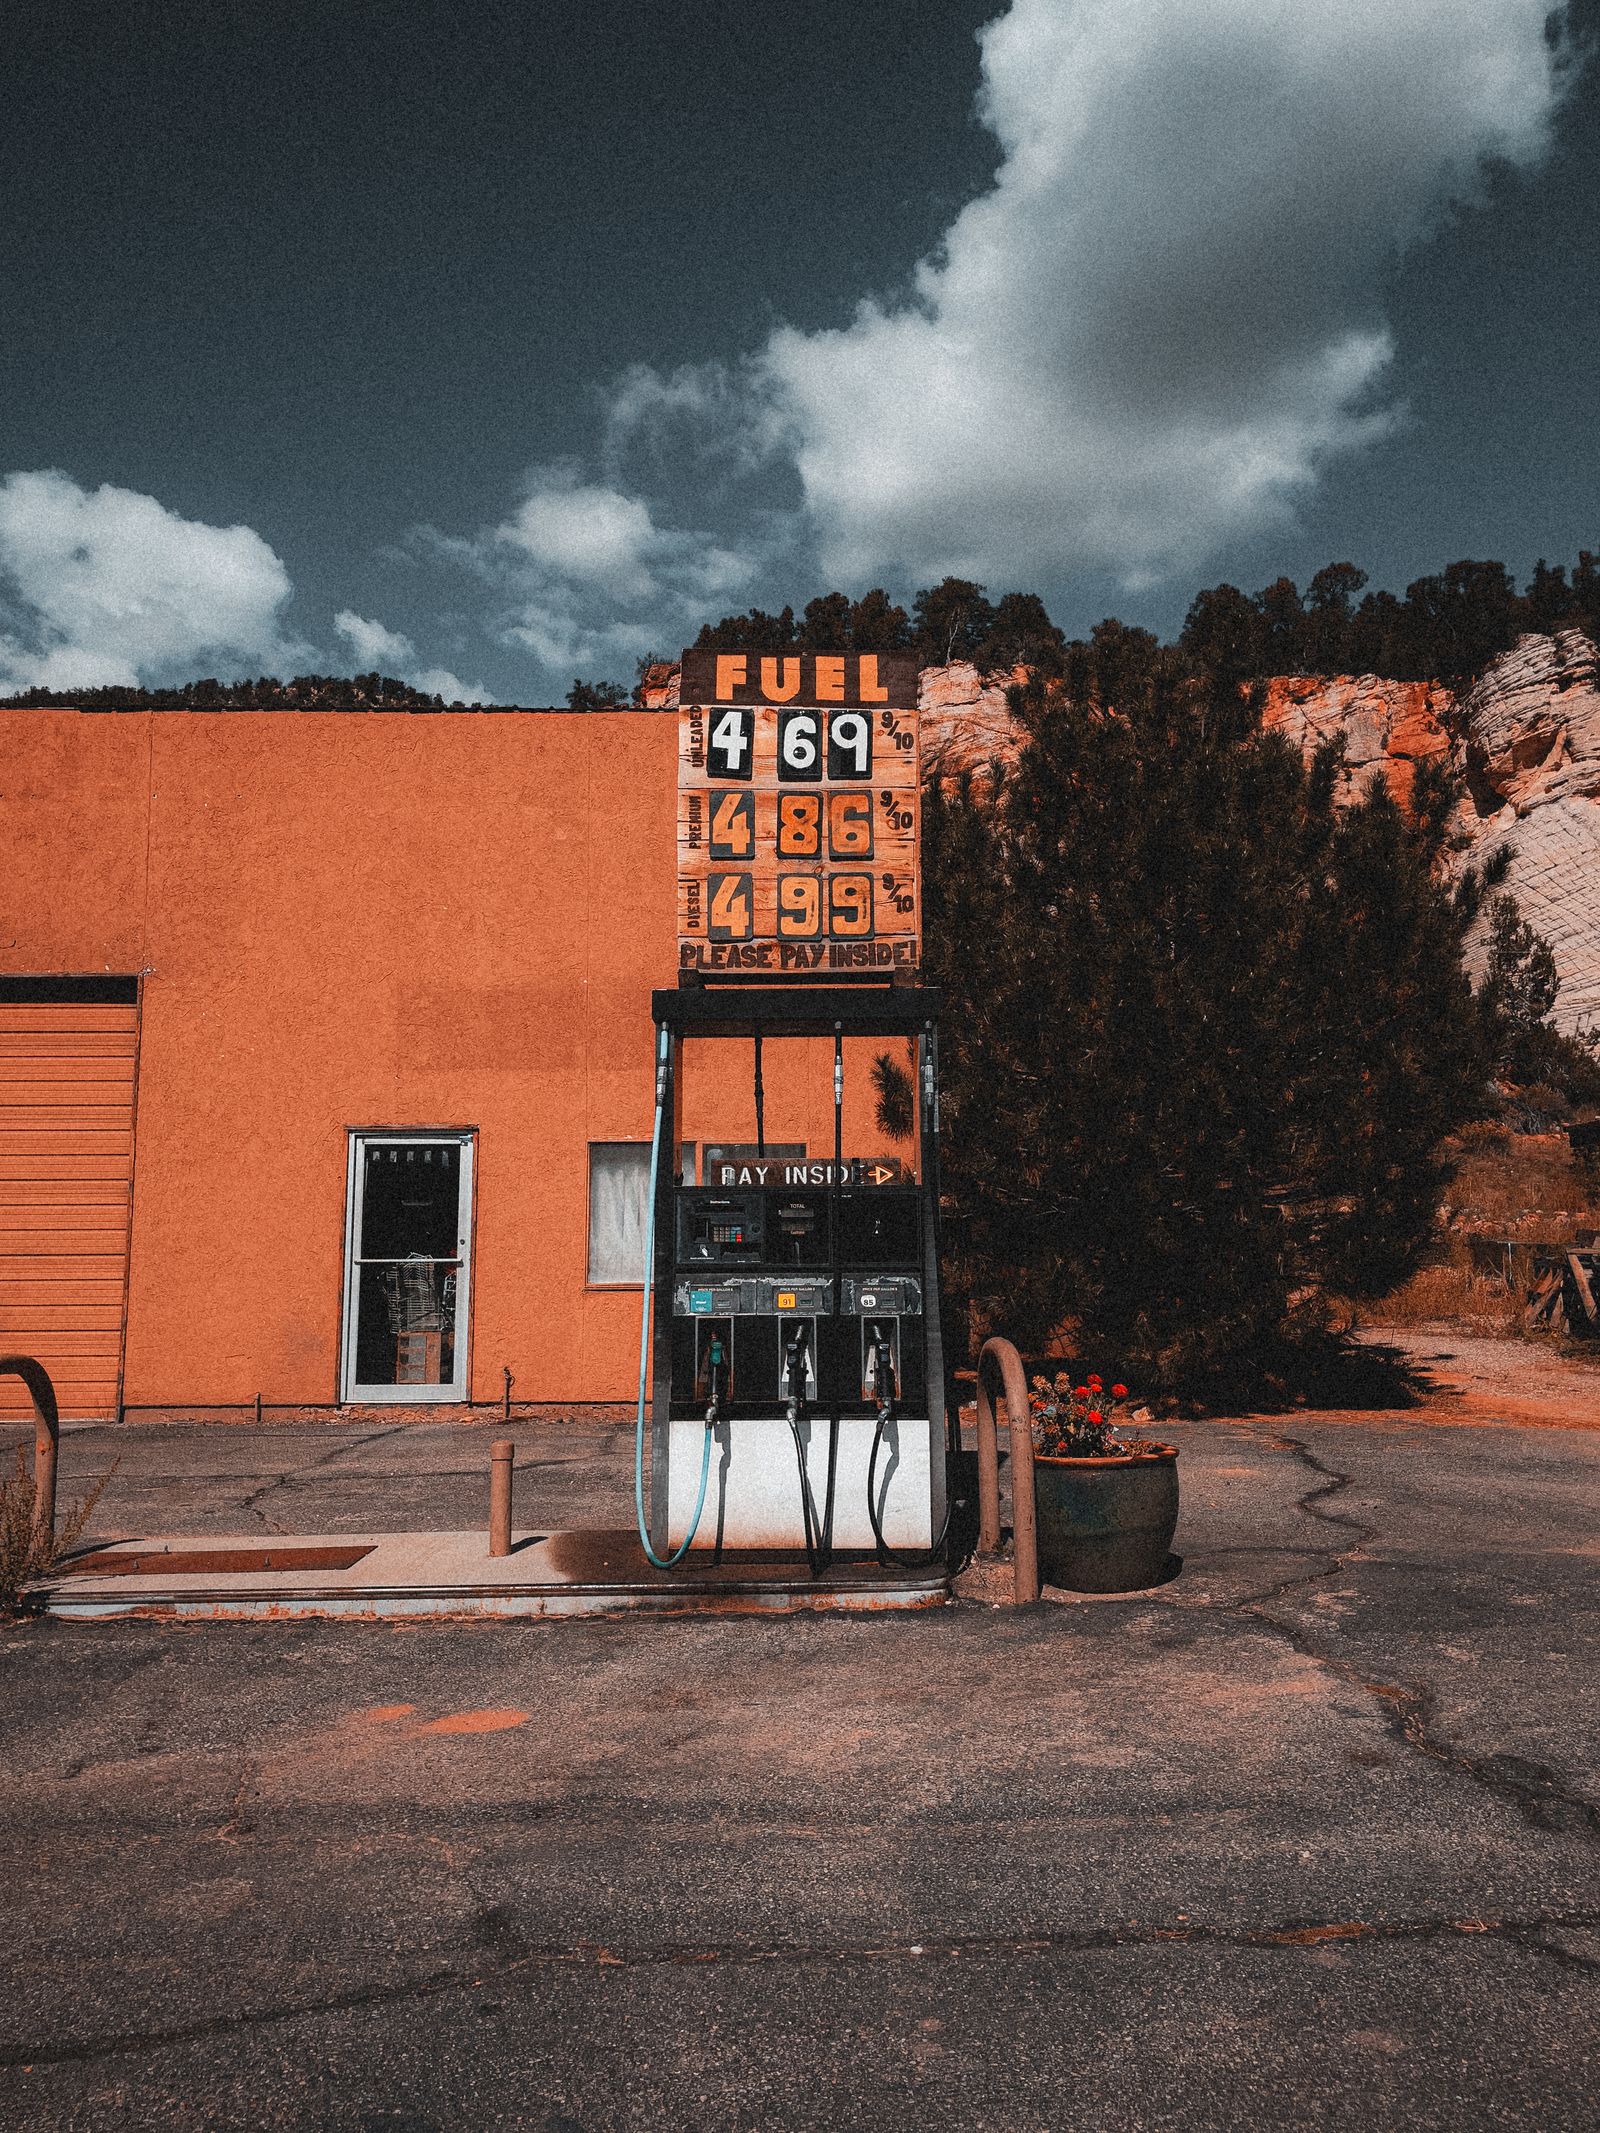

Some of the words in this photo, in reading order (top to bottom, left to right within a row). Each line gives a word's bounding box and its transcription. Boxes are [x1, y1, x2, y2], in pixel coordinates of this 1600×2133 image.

[715, 654, 889, 703] FUEL
[689, 705, 705, 768] UNLEADED
[688, 795, 702, 850] PREMIUM
[687, 880, 701, 929] DIESEL
[679, 944, 775, 969] PLEASE
[780, 944, 826, 969] PAY
[828, 939, 917, 968] INSIDE!
[782, 1298, 792, 1306] 91
